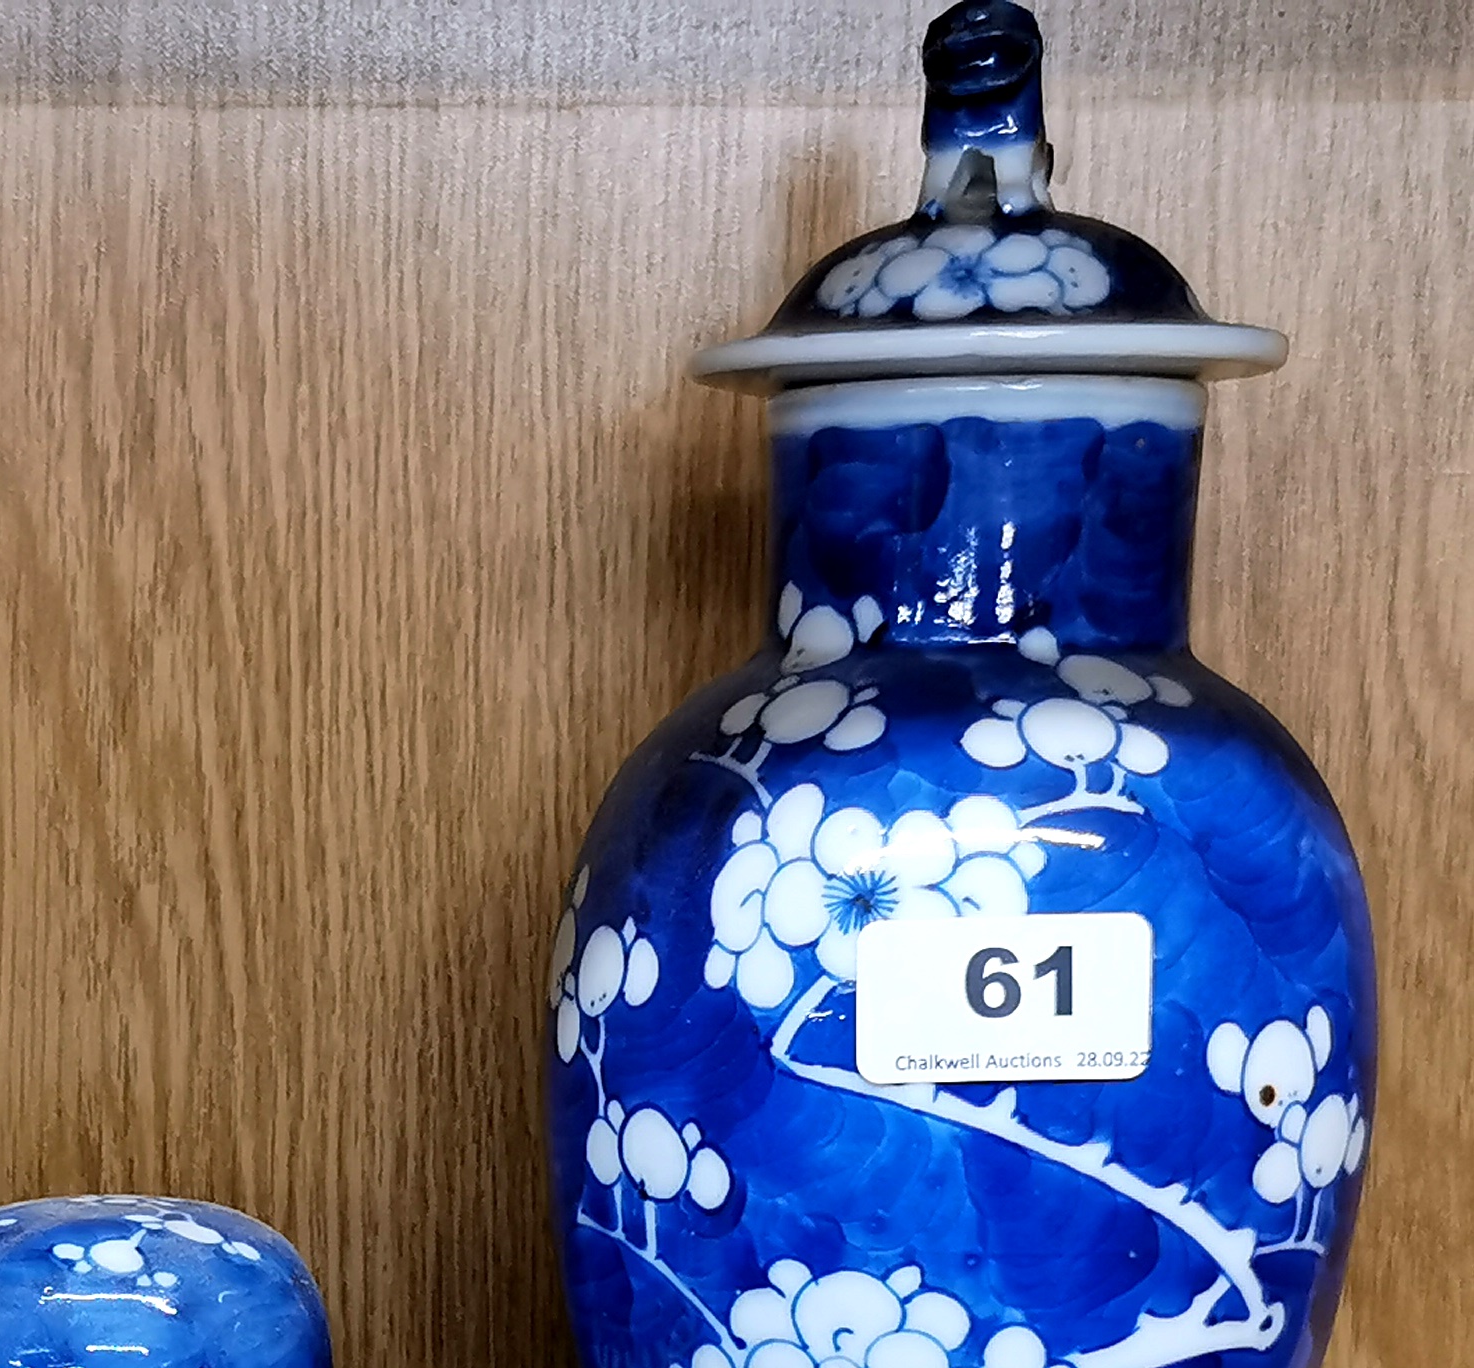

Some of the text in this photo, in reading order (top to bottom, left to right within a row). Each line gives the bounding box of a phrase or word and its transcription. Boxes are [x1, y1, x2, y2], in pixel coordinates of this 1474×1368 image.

[965, 945, 1073, 1019] 61
[895, 1053, 980, 1071] Chalkwell
[985, 1052, 1063, 1069] Auctions
